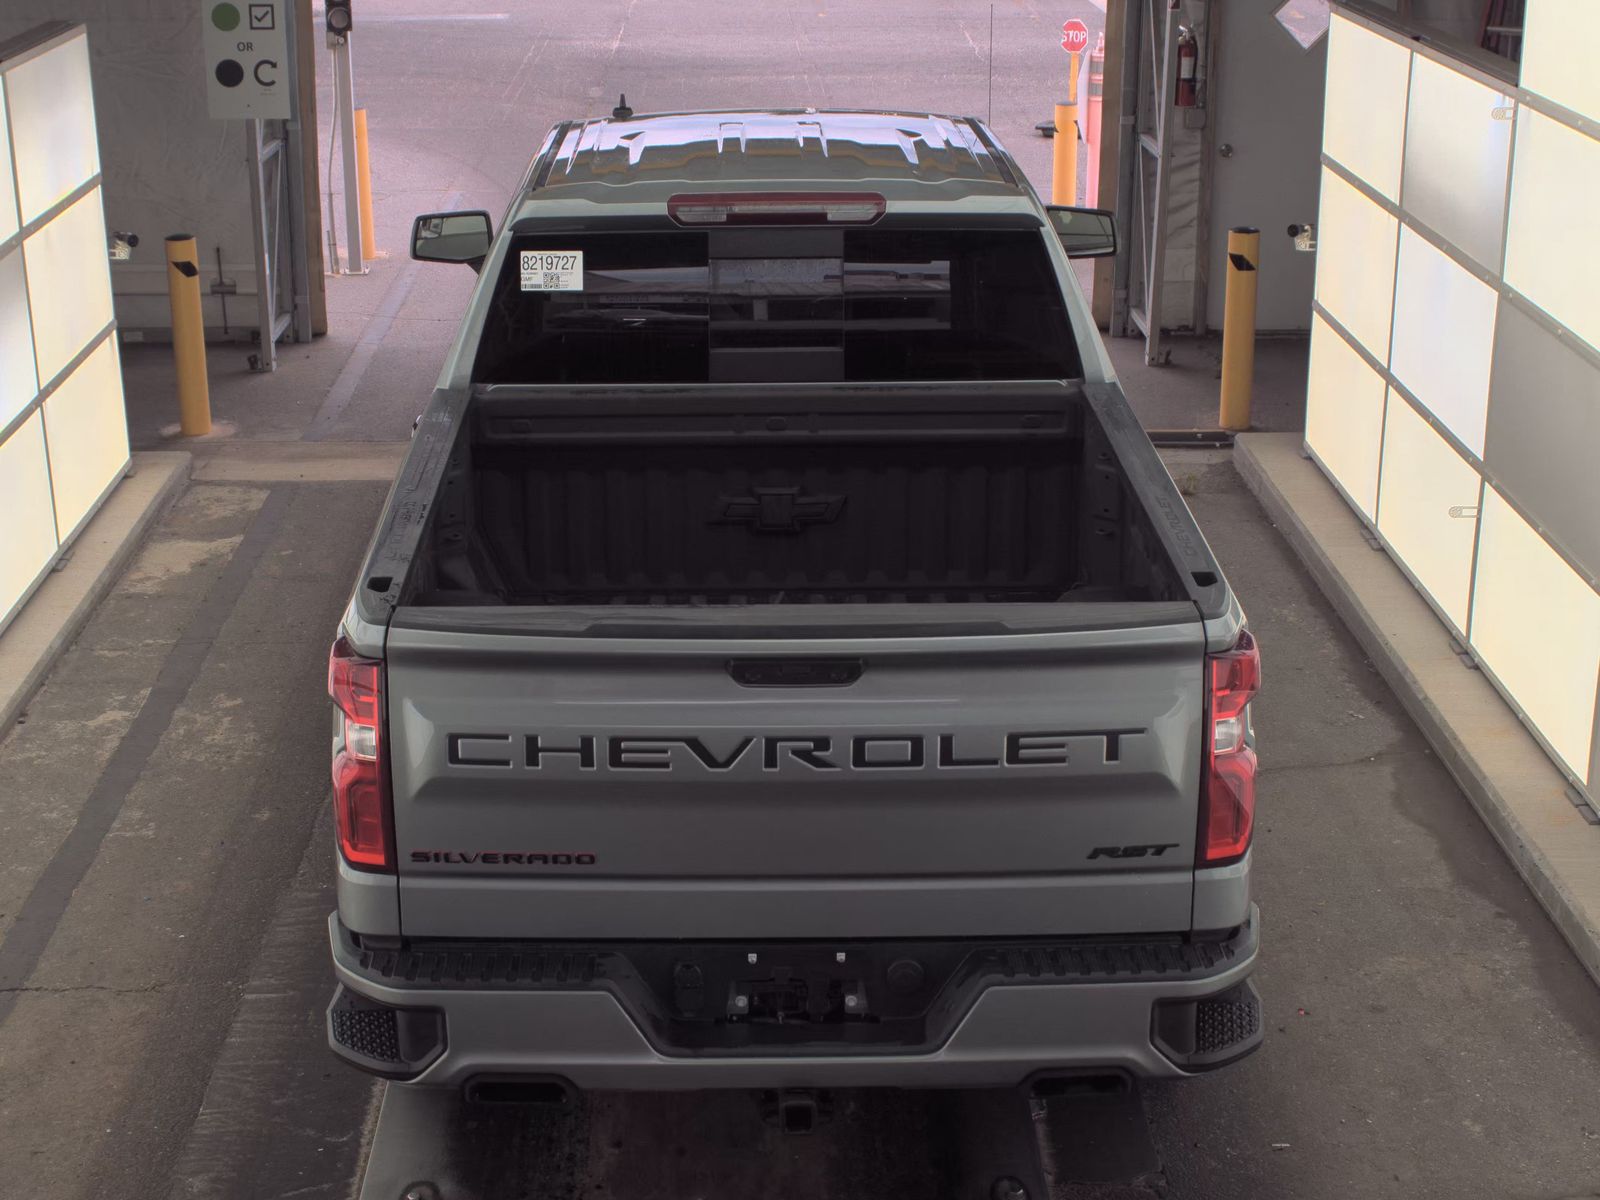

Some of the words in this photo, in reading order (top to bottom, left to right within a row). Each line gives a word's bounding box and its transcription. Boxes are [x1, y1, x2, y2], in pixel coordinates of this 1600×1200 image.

[1062, 30, 1087, 42] STOP
[236, 41, 254, 52] OR
[522, 255, 577, 271] 8219727
[447, 729, 1147, 772] CHEVROLET
[410, 851, 596, 866] SILVERADO
[1086, 843, 1180, 860] RST
